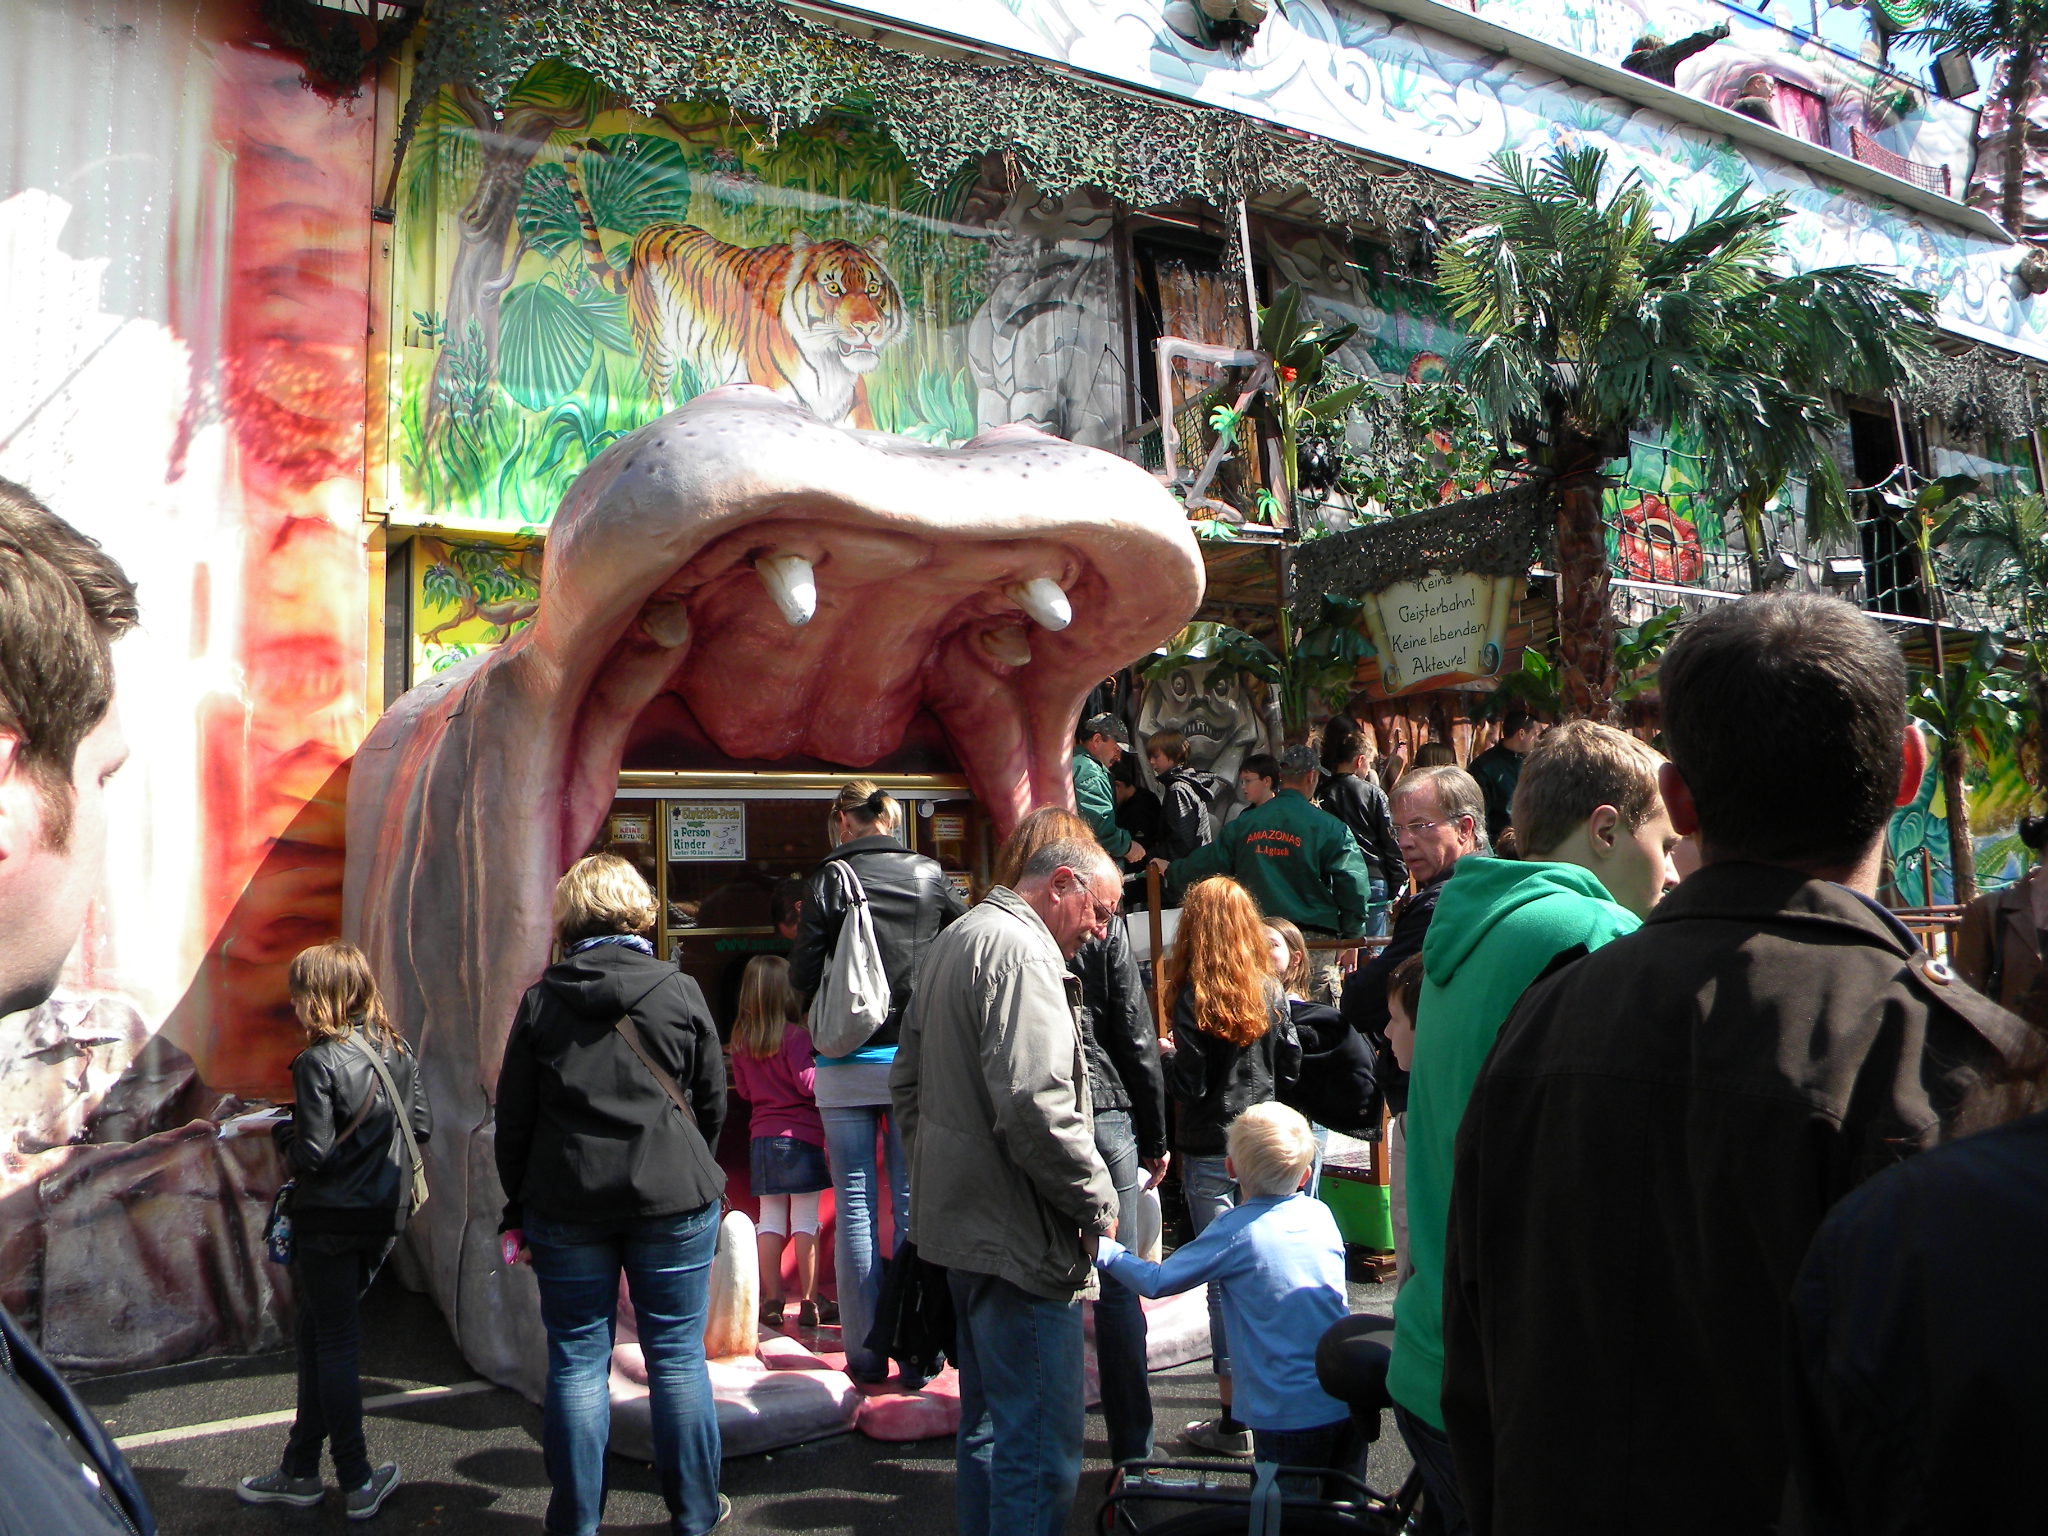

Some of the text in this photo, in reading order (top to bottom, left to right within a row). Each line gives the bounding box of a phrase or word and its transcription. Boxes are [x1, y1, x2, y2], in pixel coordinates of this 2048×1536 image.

[1417, 574, 1453, 592] Keine
[1399, 588, 1475, 623] Geisterbahn!
[1392, 620, 1487, 653] Keine lebenden
[1412, 647, 1466, 675] Akteure!
[681, 826, 711, 837] Person
[1246, 829, 1302, 847] AMAZONAS
[674, 839, 706, 850] Kinder
